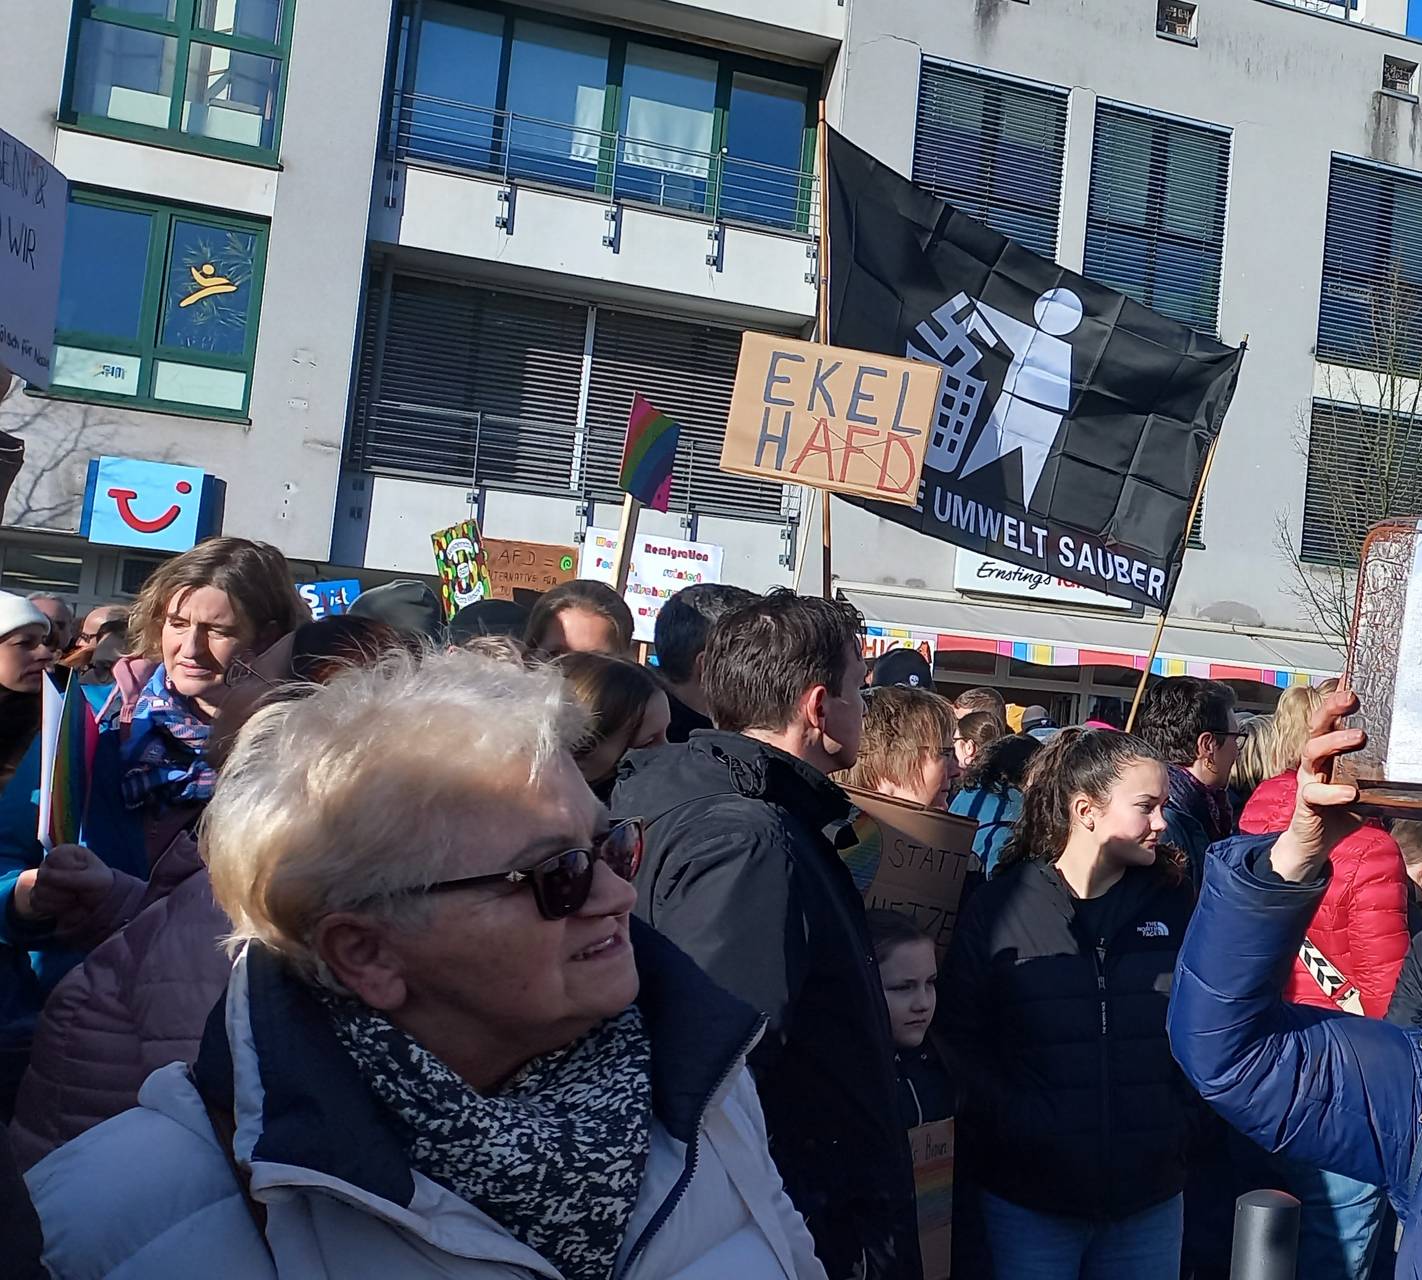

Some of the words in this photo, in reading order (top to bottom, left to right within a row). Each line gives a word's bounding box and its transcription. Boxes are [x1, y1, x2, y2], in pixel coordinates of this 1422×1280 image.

[7, 214, 36, 271] WIR
[763, 350, 923, 436] EKEL
[754, 407, 917, 495] HAFD
[498, 548, 537, 566] AFD
[644, 542, 709, 562] Remigration
[933, 486, 1049, 560] UMWELT
[1057, 534, 1167, 601] SAUBER
[975, 560, 1053, 590] Ernstings
[887, 838, 969, 881] STATT
